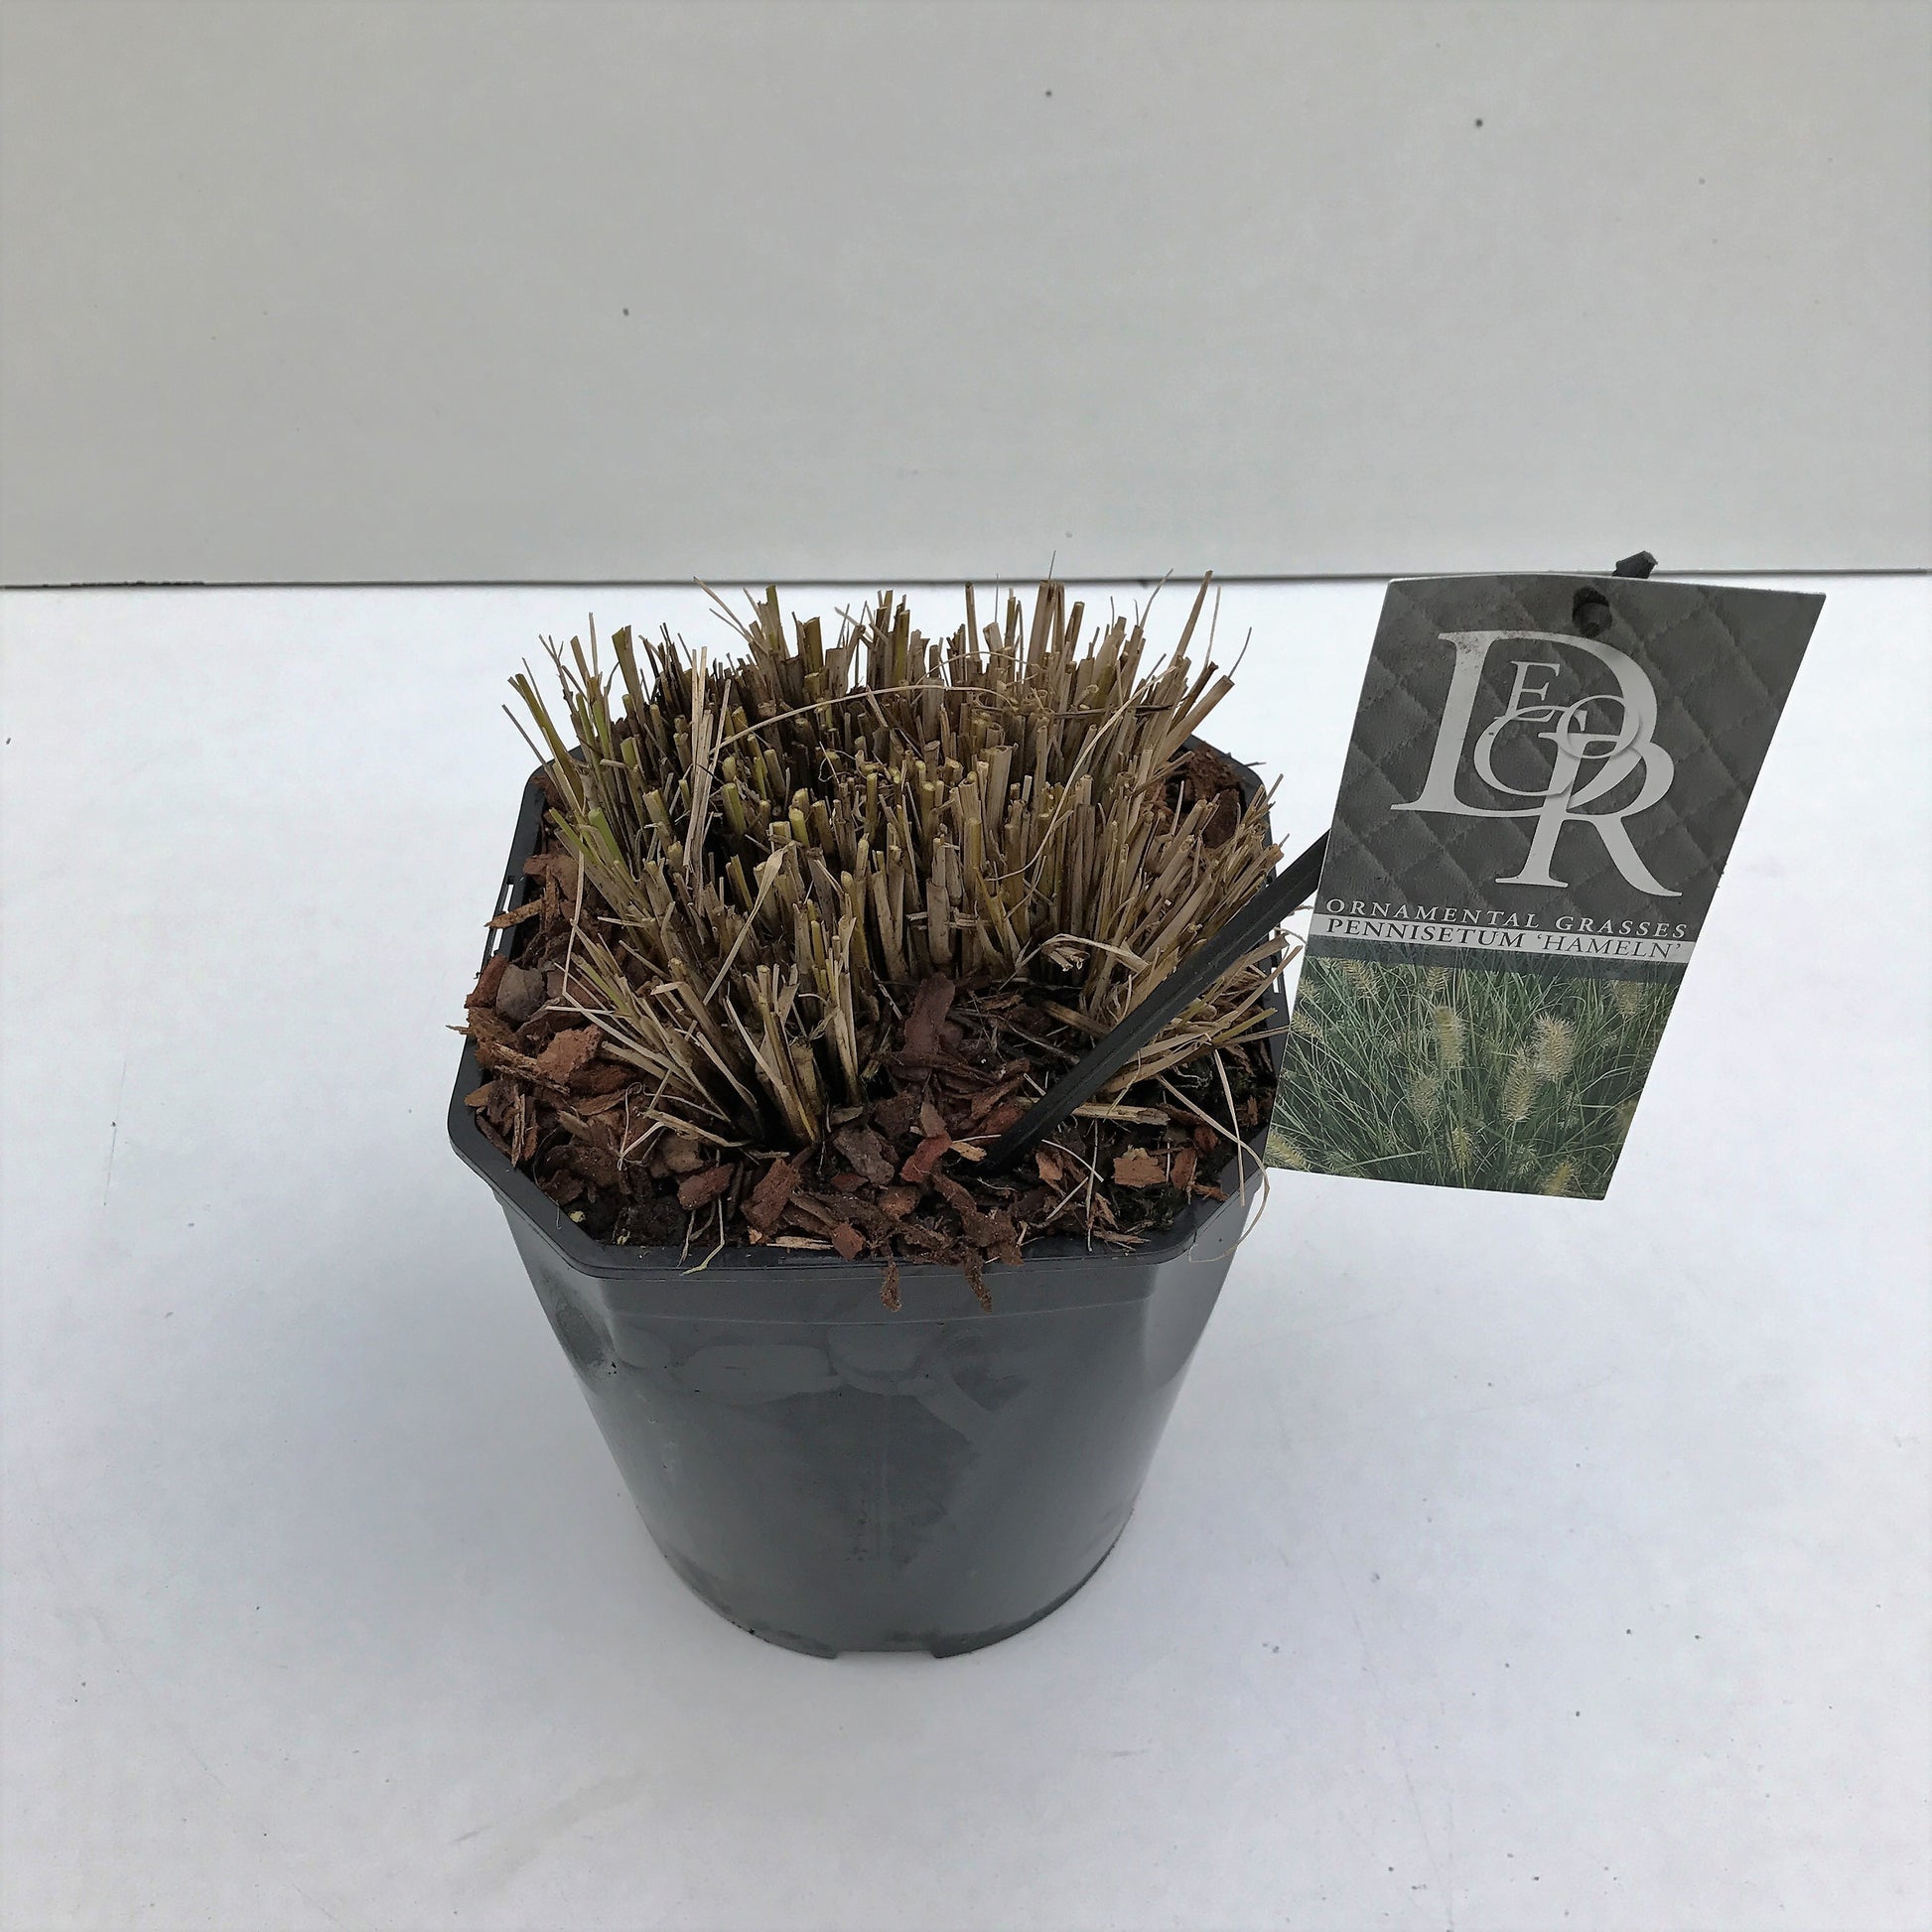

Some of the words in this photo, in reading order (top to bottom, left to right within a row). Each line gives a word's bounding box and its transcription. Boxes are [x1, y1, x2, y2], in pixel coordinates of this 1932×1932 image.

[1326, 898, 1539, 928] ORNAMENTAL
[1555, 915, 1687, 938] GRASSES
[1327, 919, 1524, 948] PENNISETUM
